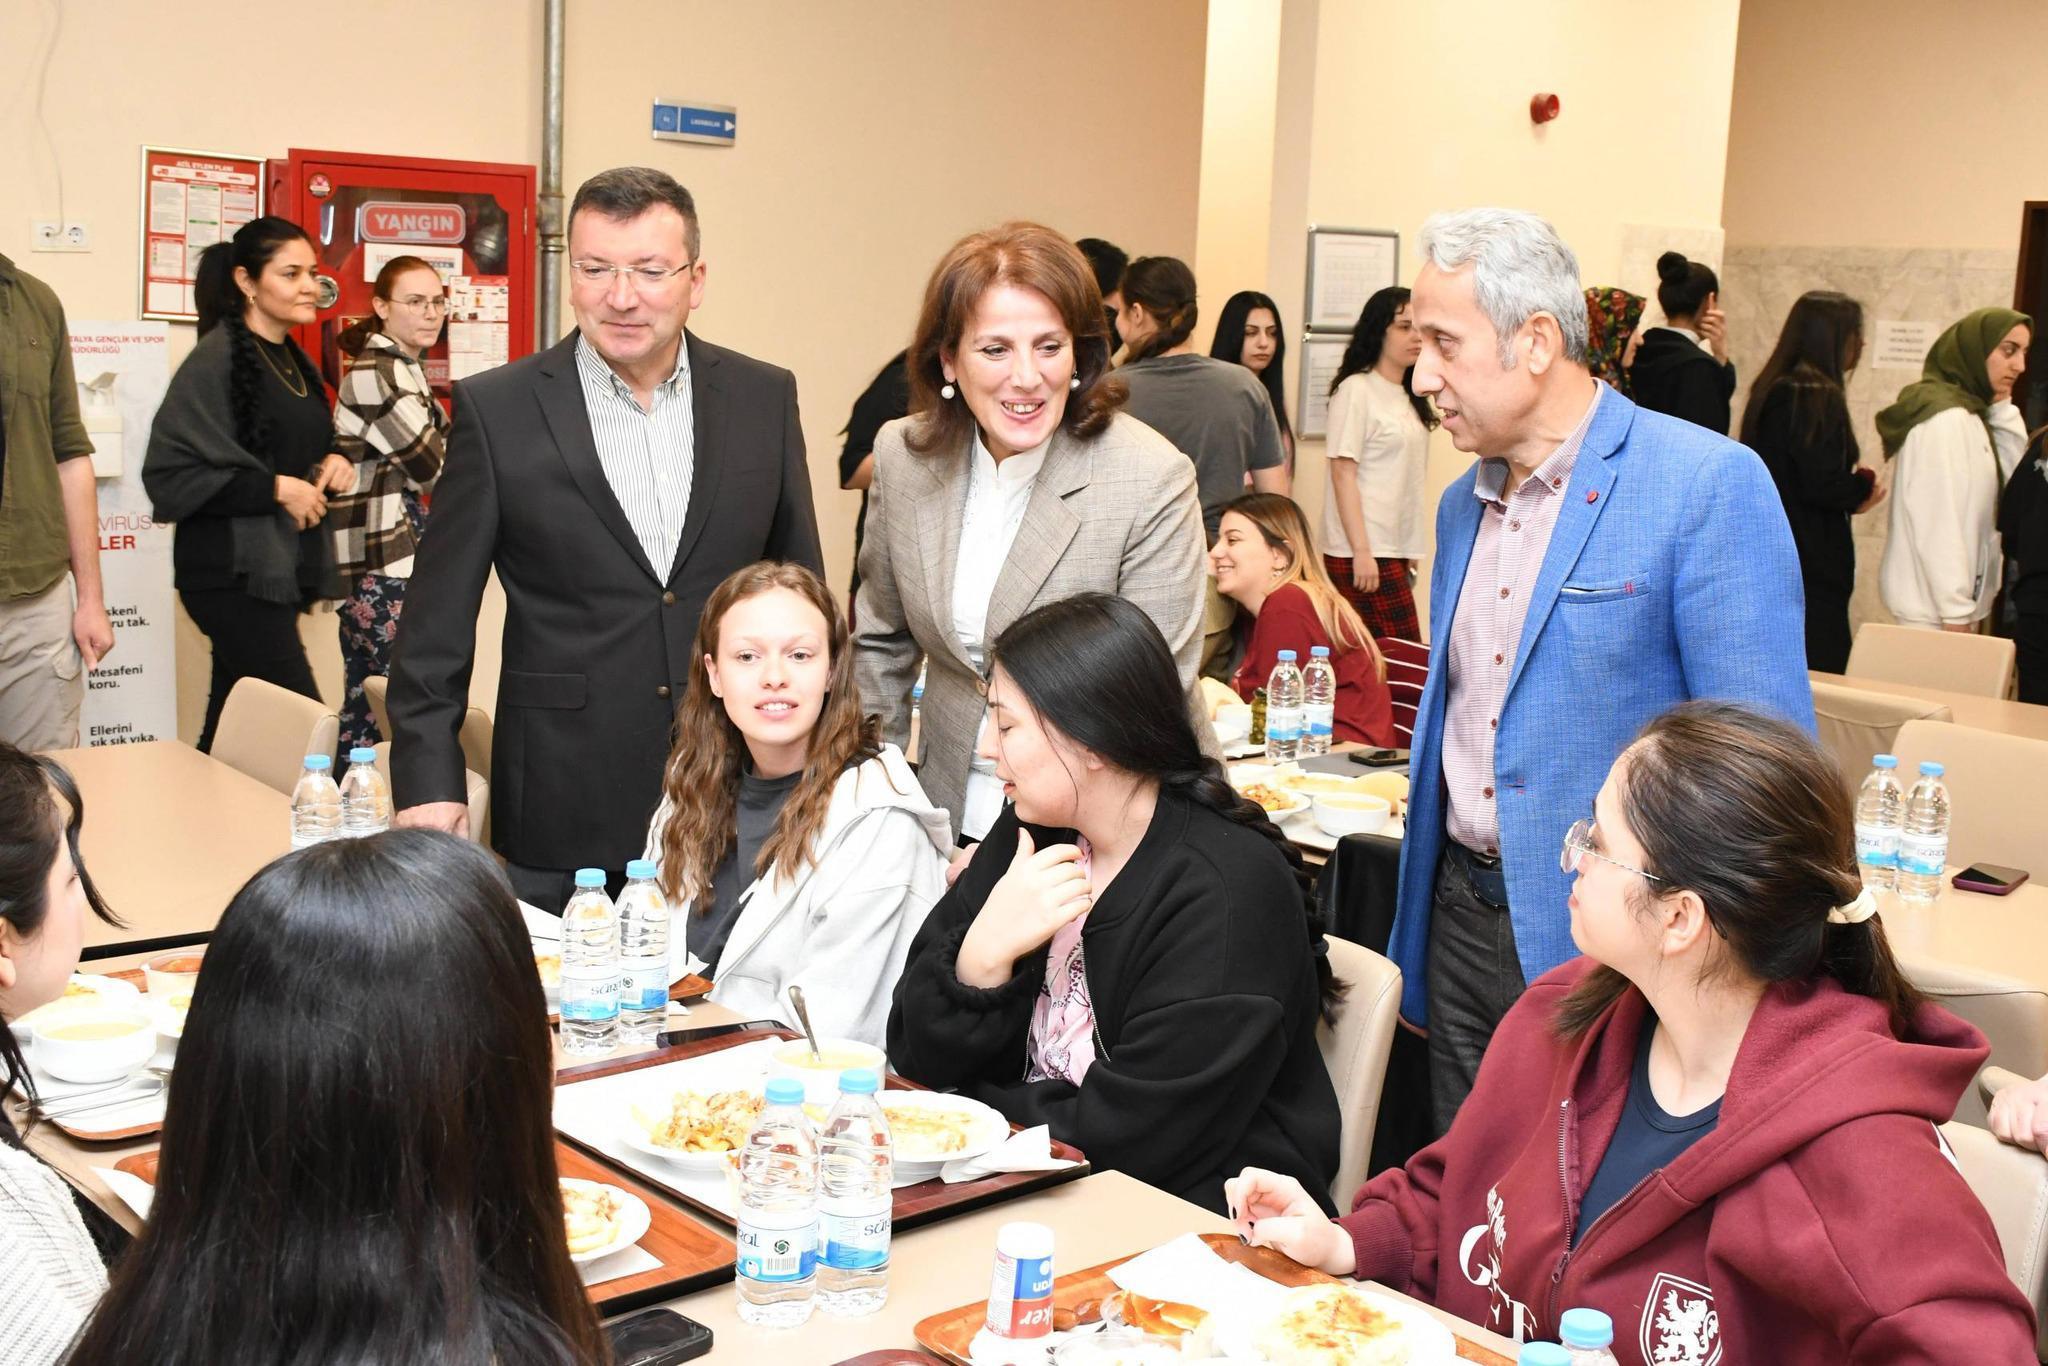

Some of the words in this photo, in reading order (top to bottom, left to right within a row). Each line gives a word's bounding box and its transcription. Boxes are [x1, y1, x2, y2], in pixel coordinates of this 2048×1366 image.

[374, 214, 454, 232] YANGIN
[131, 335, 141, 343] VE
[98, 535, 136, 551] LER
[105, 605, 137, 616] skeni
[111, 620, 124, 628] ru
[127, 616, 150, 627] tak.
[88, 664, 143, 678] Mesafeni
[89, 680, 120, 690] koru.
[90, 723, 133, 736] Ellerini
[1020, 1304, 1052, 1325] ker
